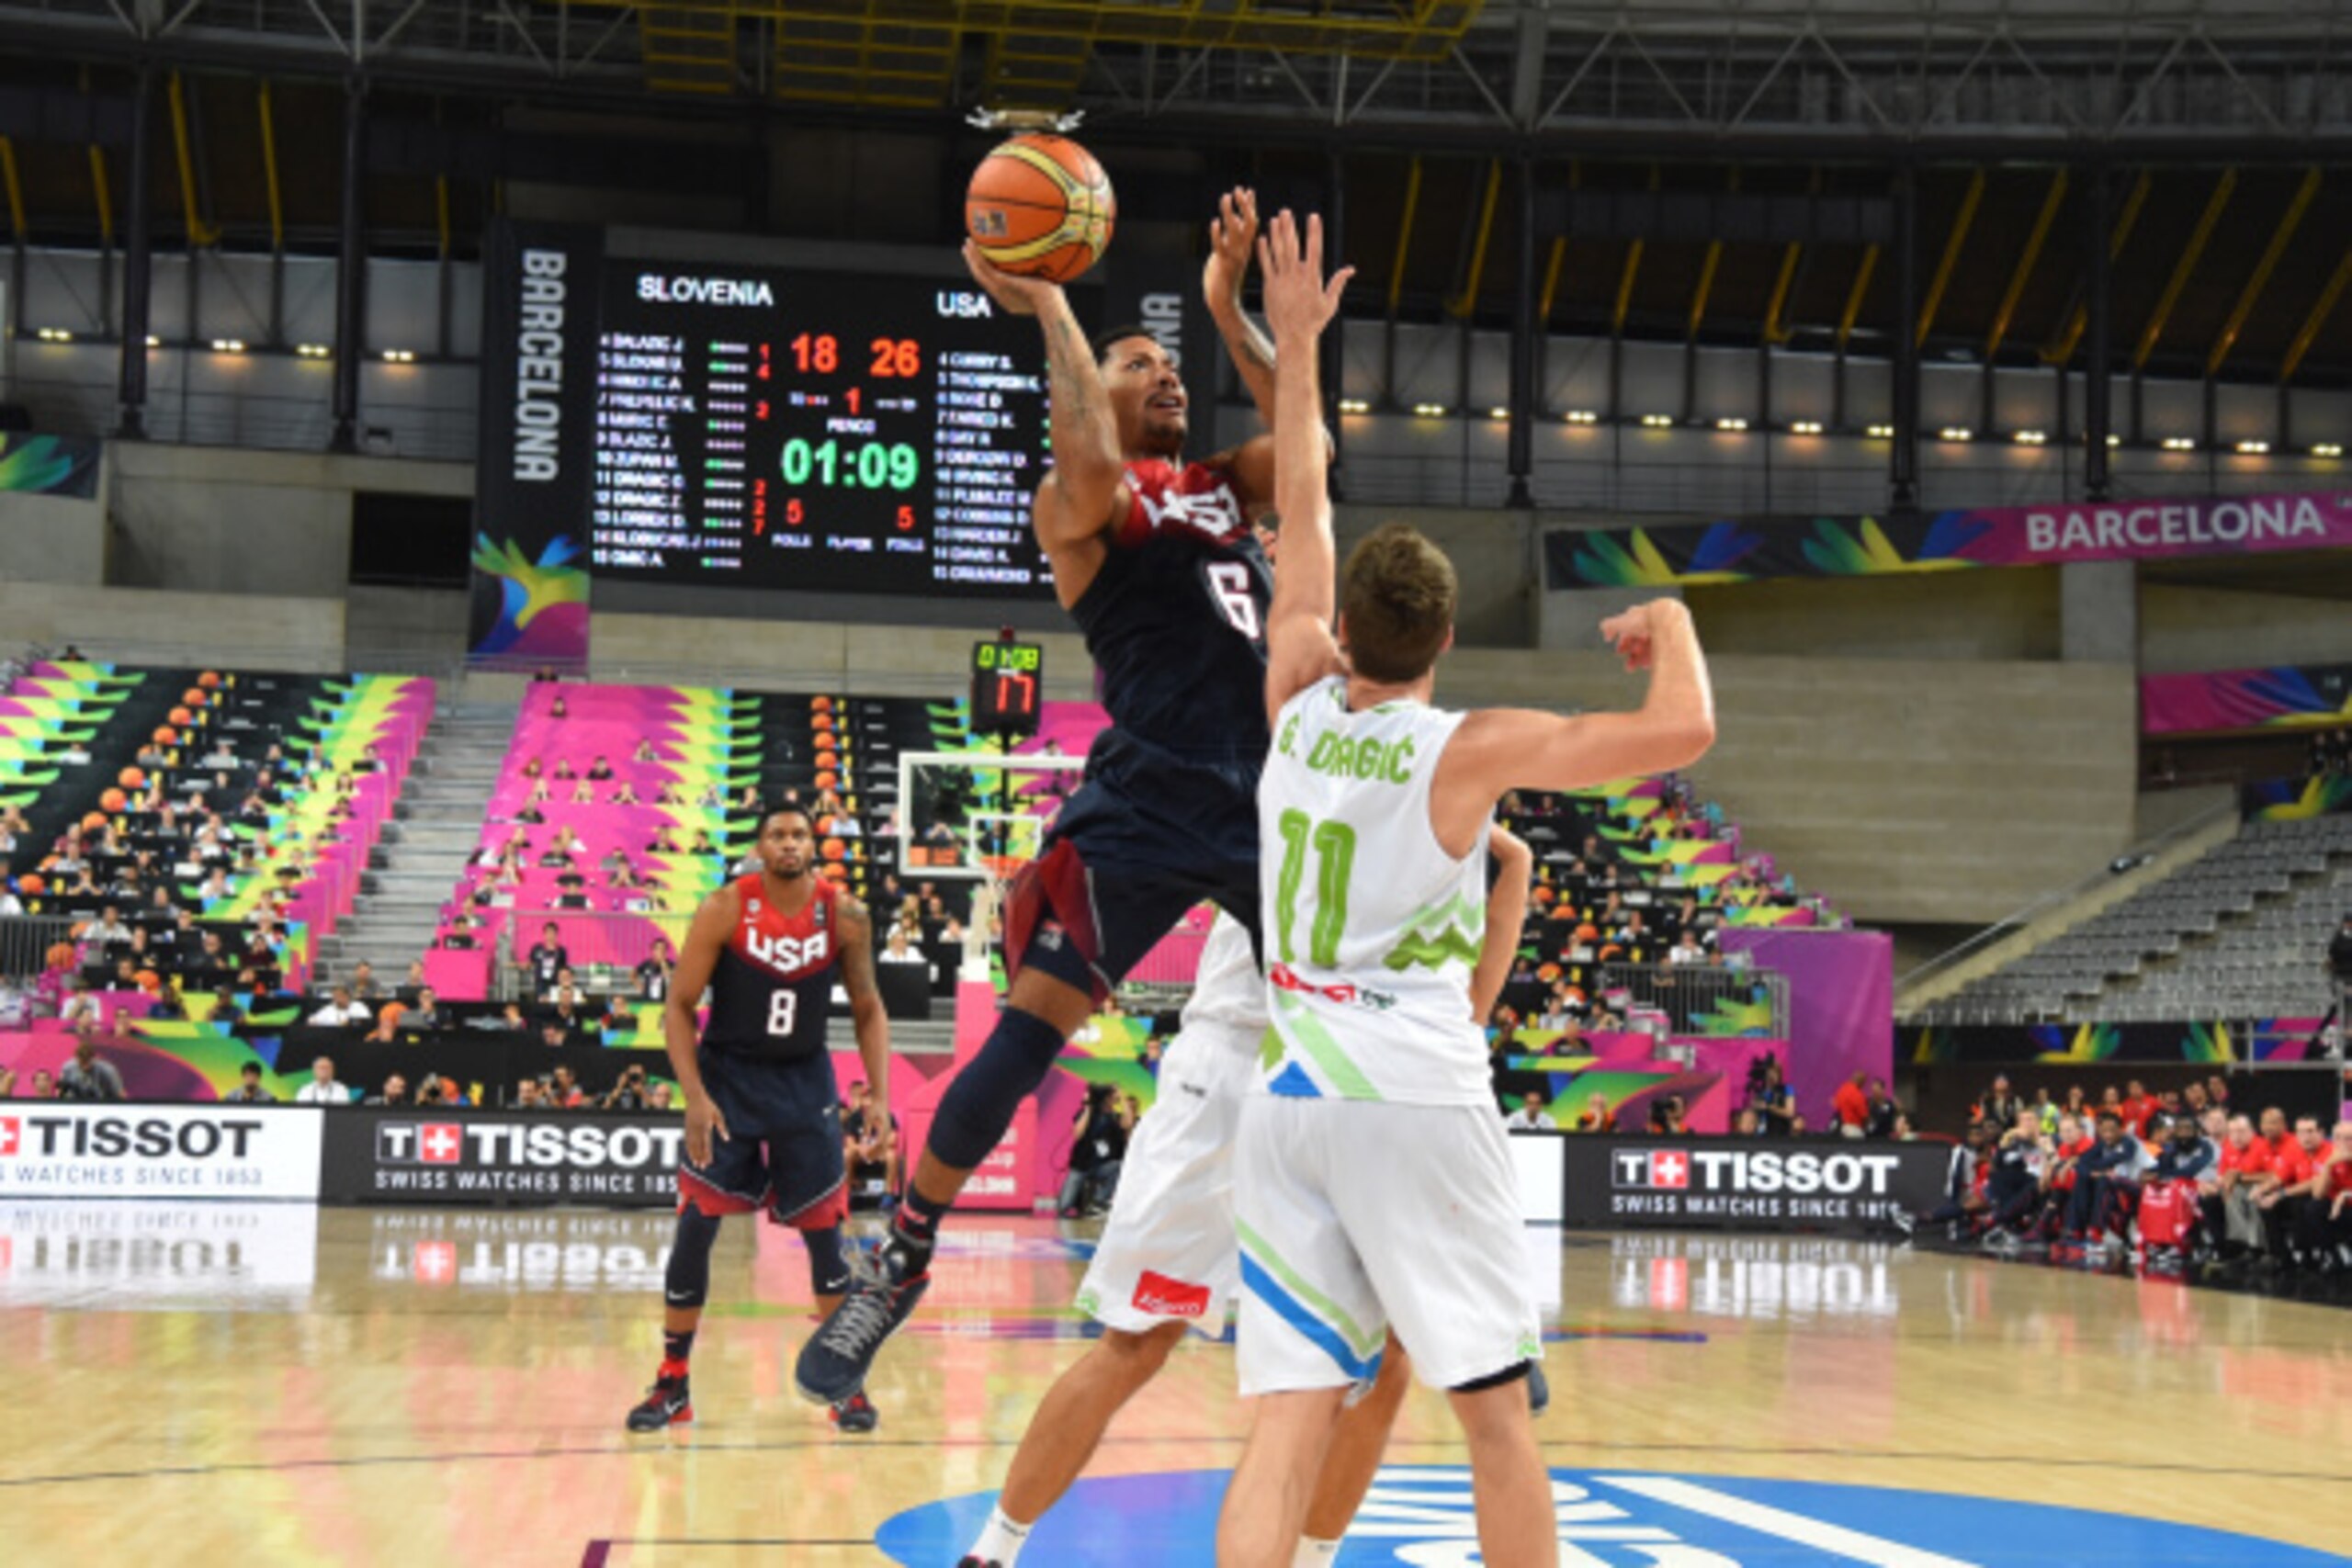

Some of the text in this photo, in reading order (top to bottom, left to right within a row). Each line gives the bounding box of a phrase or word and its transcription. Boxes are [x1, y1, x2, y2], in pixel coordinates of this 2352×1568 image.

[638, 275, 774, 306] SLOVENIA
[936, 290, 992, 319] USA
[514, 248, 567, 481] BARCELONA
[756, 362, 771, 380] 4
[791, 333, 838, 373] 18
[869, 337, 920, 378] 26
[844, 387, 861, 414] 1
[596, 470, 611, 485] 11
[782, 437, 920, 490] 01:09
[752, 518, 764, 536] 7
[786, 498, 804, 524] 5
[896, 505, 914, 530] 5
[2026, 498, 2326, 552] BARCELONA
[1206, 561, 1260, 638] 6
[997, 674, 1035, 713] 17
[1276, 807, 1355, 968] 11
[746, 926, 828, 974] USA
[768, 988, 797, 1035] 8
[28, 1117, 263, 1158] TISSOT
[466, 1123, 685, 1168] TISSOT
[16, 1165, 124, 1186] WATCHES
[137, 1167, 203, 1186] SINCE
[375, 1169, 447, 1190] SWISS
[456, 1170, 560, 1191] WATCHES
[570, 1173, 634, 1193] SINCE
[1693, 1151, 1899, 1194] TISSOT
[1611, 1196, 1677, 1214] SWISS
[1687, 1198, 1781, 1217] WATCHES
[1789, 1199, 1849, 1218] SINCE
